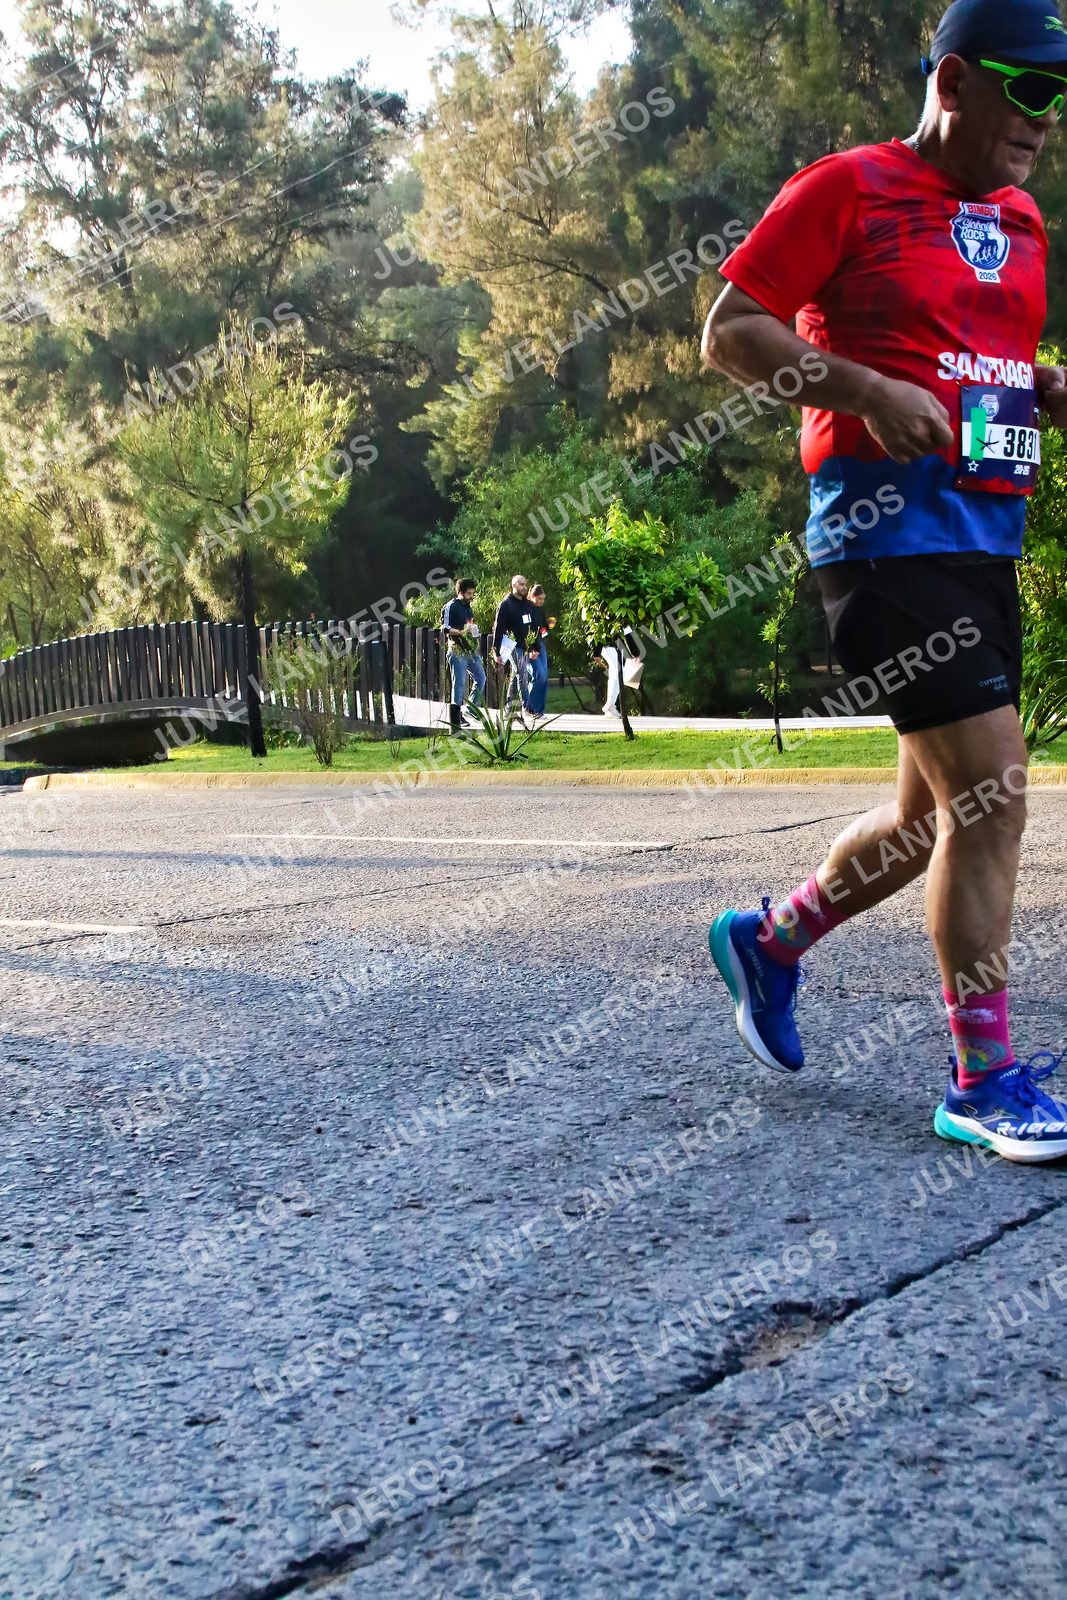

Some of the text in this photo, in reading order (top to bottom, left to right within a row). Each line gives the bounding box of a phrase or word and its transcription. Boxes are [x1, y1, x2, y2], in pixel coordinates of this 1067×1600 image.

[967, 204, 996, 217] BIMBO
[960, 227, 985, 240] Race
[979, 271, 998, 281] 2026
